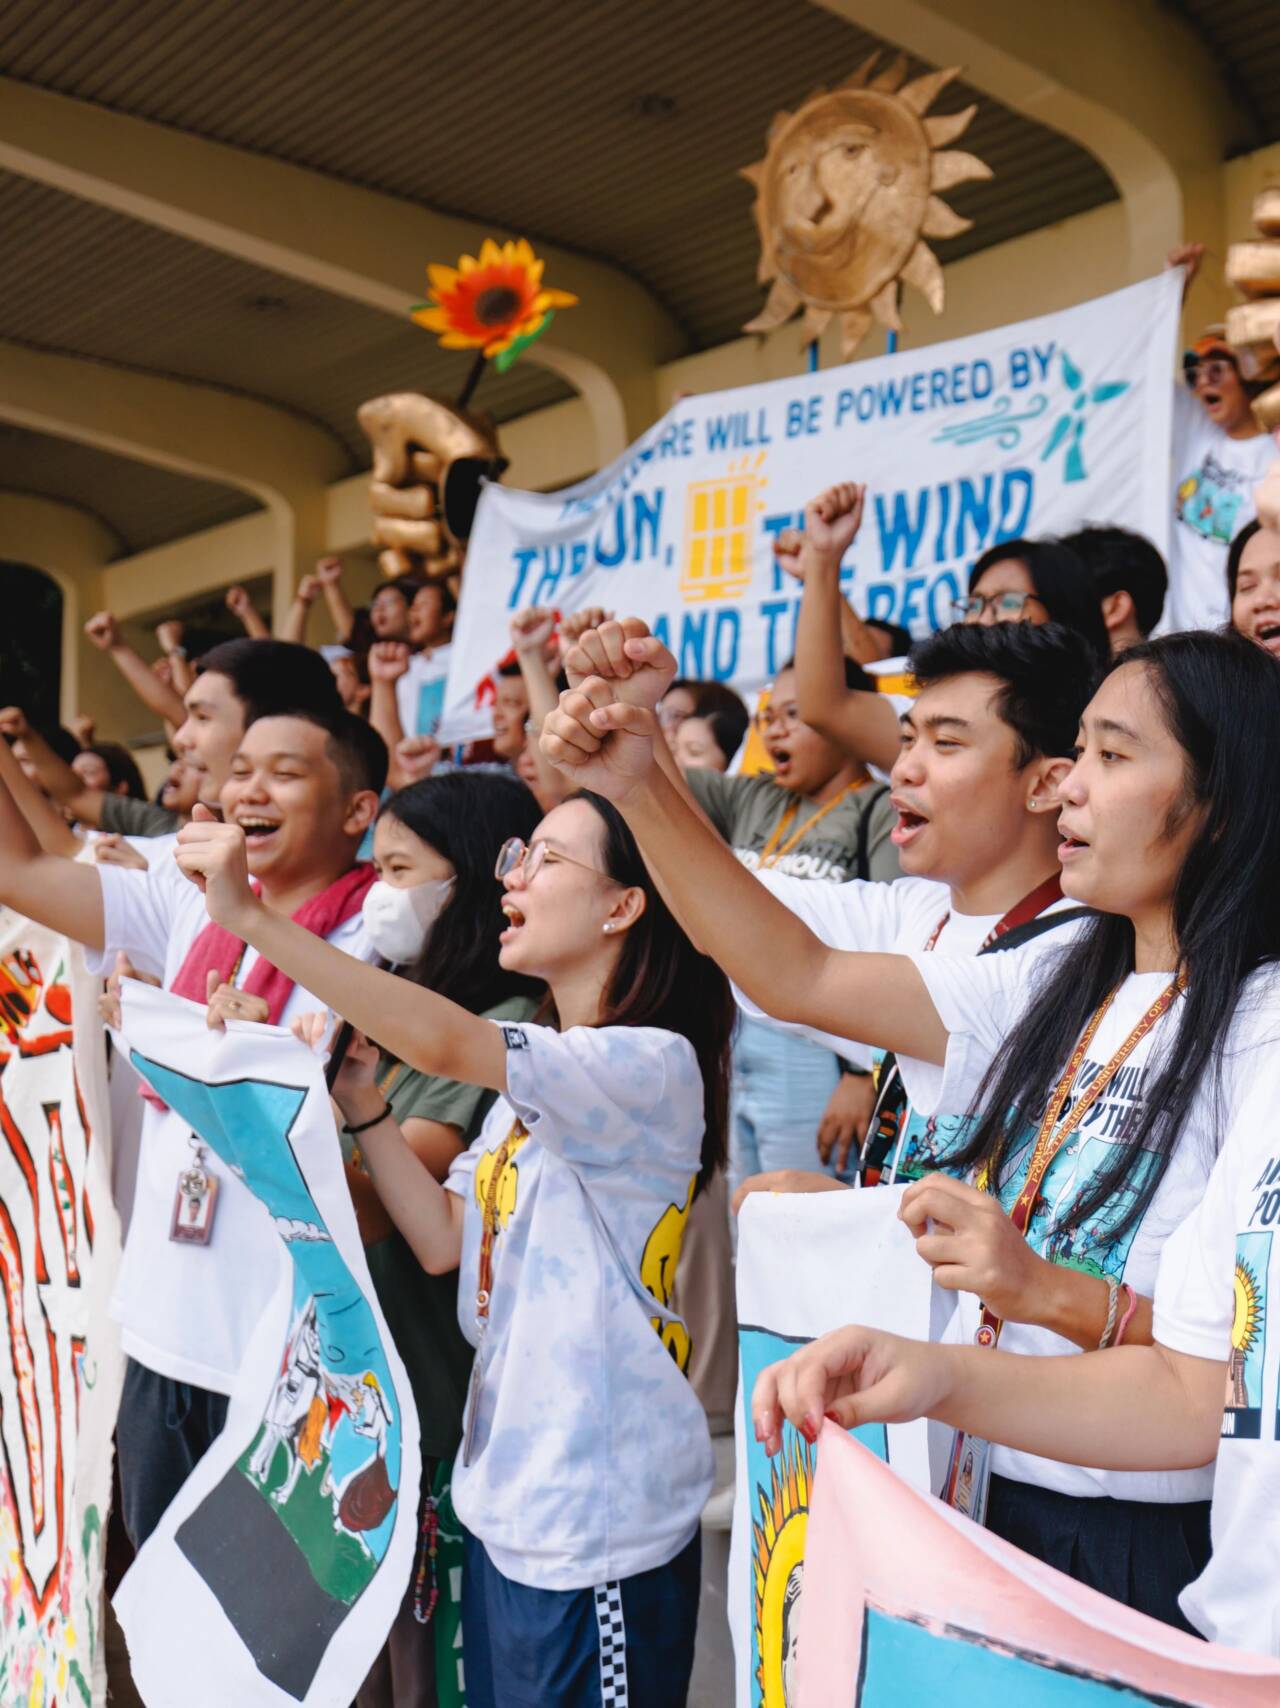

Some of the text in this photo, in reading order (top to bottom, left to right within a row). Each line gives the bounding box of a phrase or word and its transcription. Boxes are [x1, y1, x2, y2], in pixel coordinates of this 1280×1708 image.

[706, 342, 1056, 451] WILL BE POWERED BY
[873, 466, 1034, 572] WIND
[1089, 1019, 1149, 1091] UNIVERSITY
[1147, 996, 1167, 1018] OF
